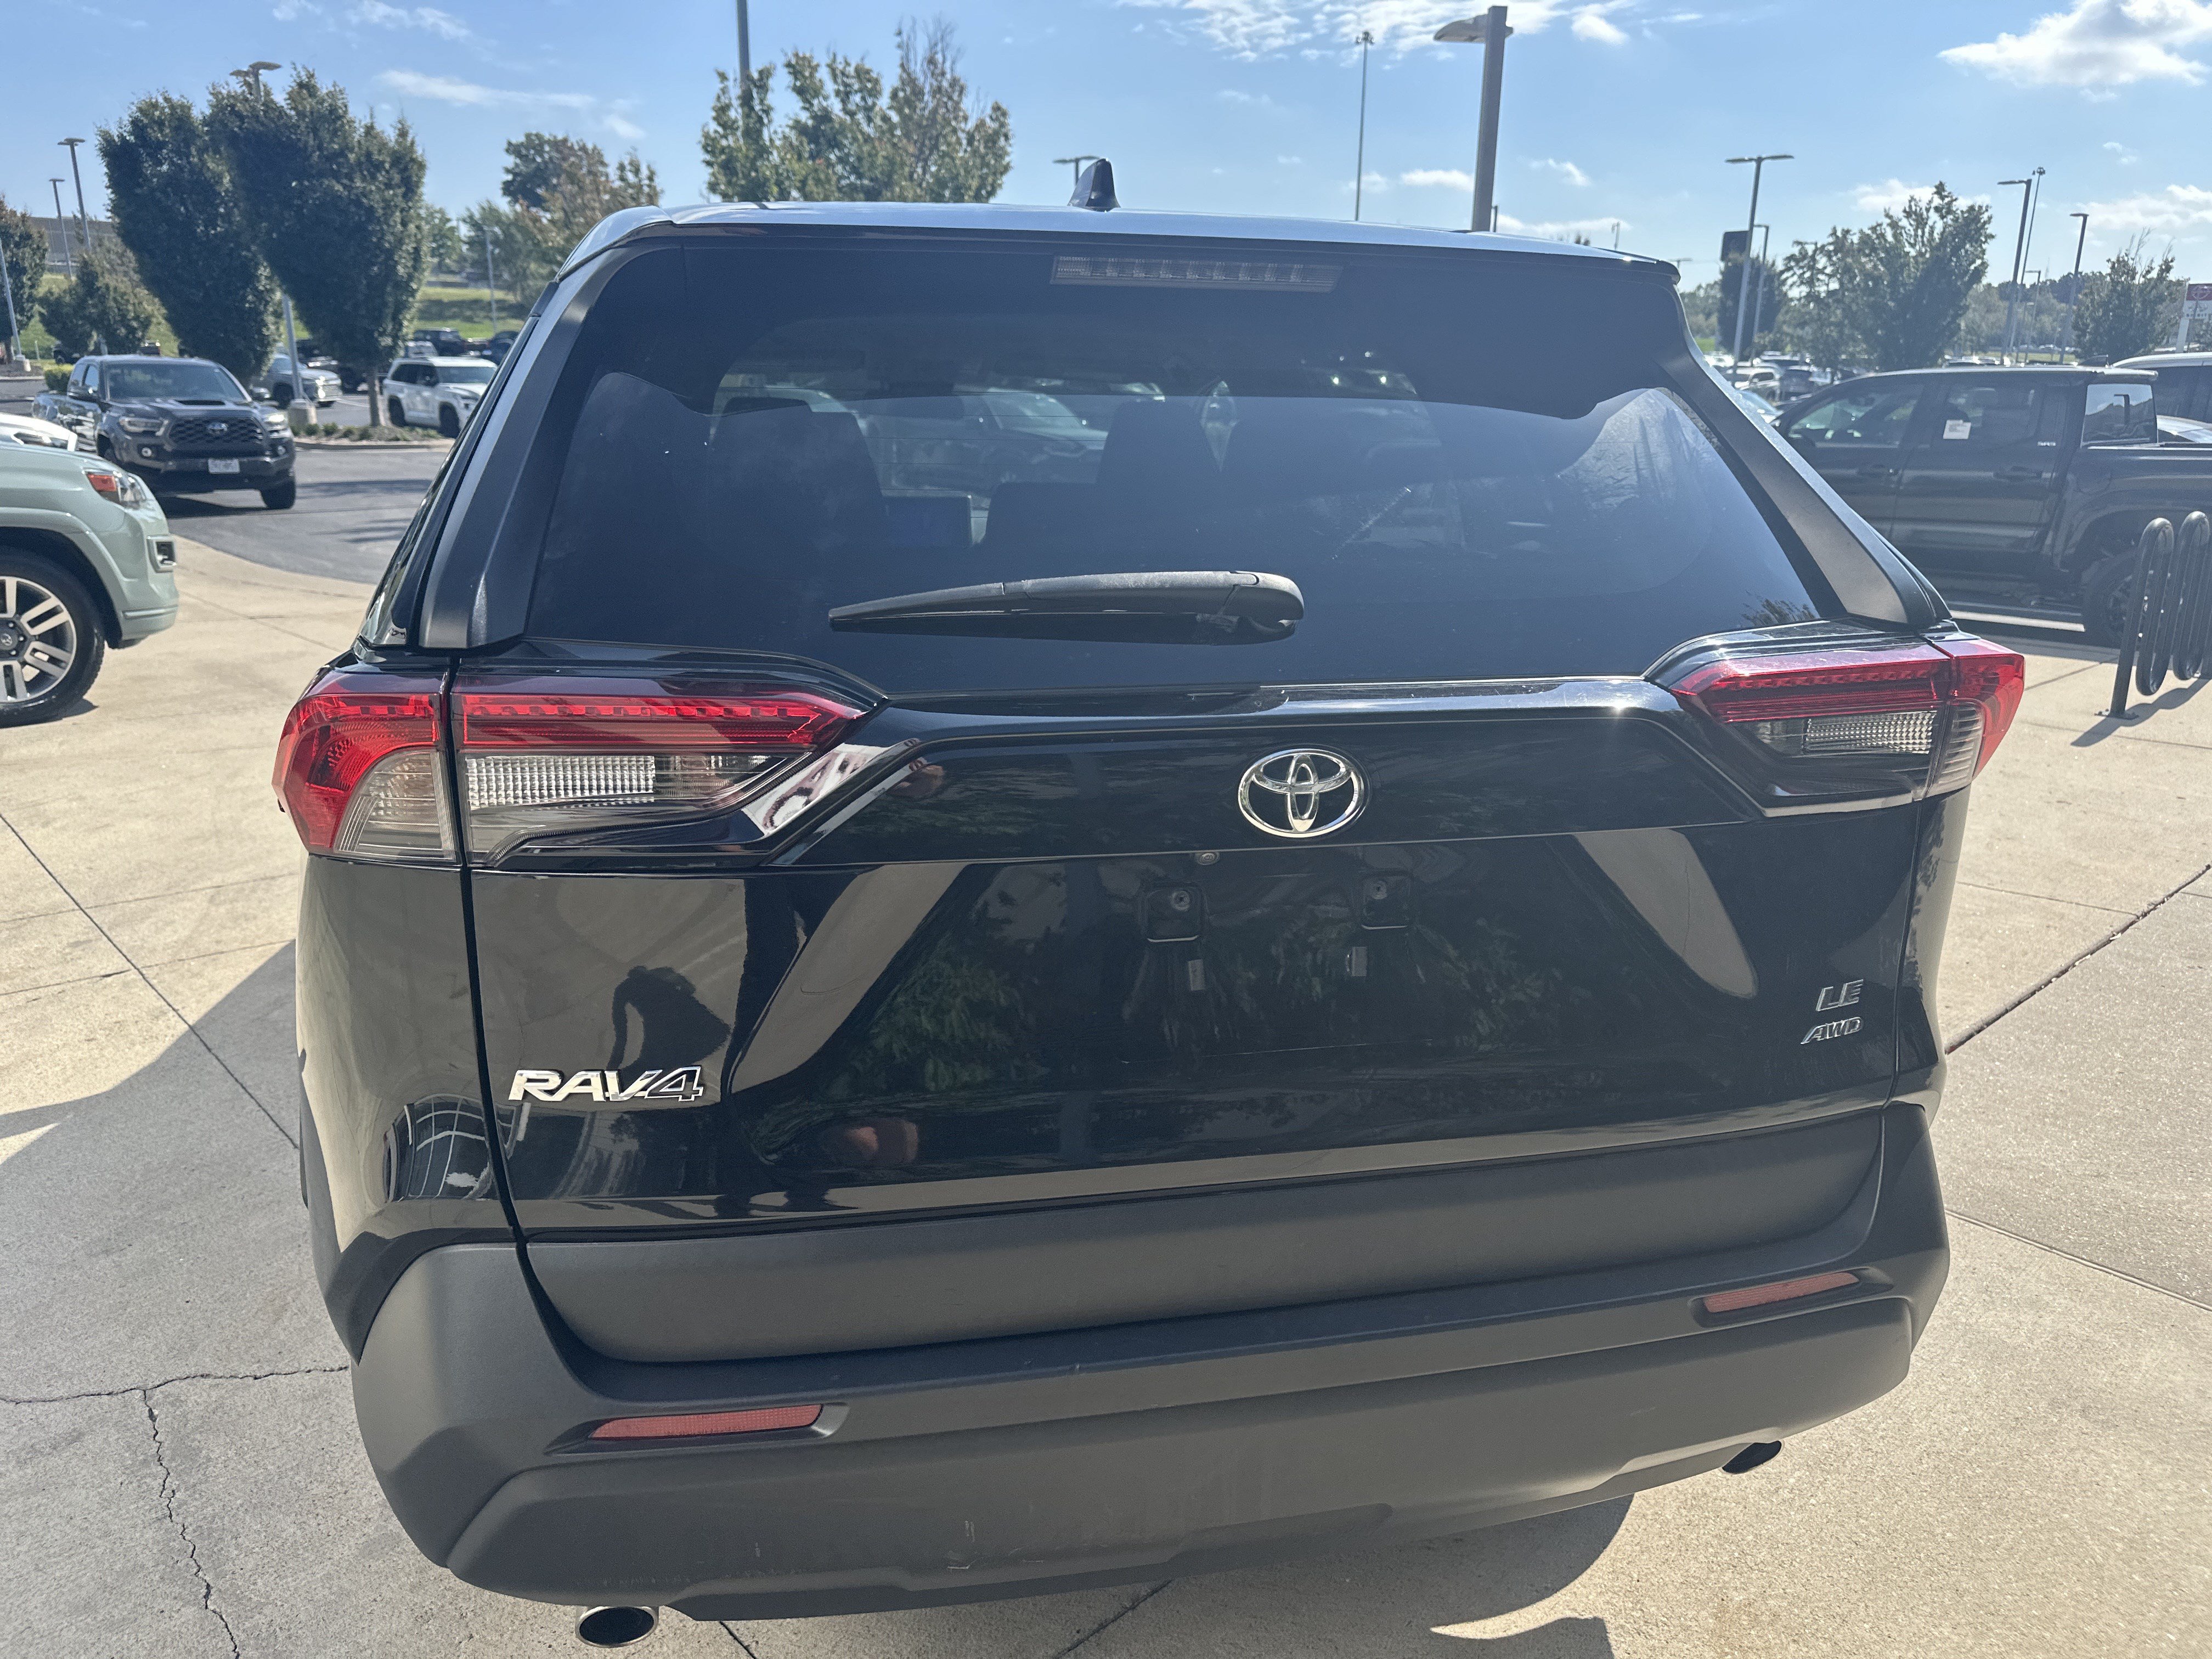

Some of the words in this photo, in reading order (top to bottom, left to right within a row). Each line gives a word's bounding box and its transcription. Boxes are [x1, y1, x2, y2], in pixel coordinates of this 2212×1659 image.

[1815, 979, 1864, 1012] LE
[1800, 1017, 1864, 1045] AWD
[508, 1065, 704, 1102] RAV4
